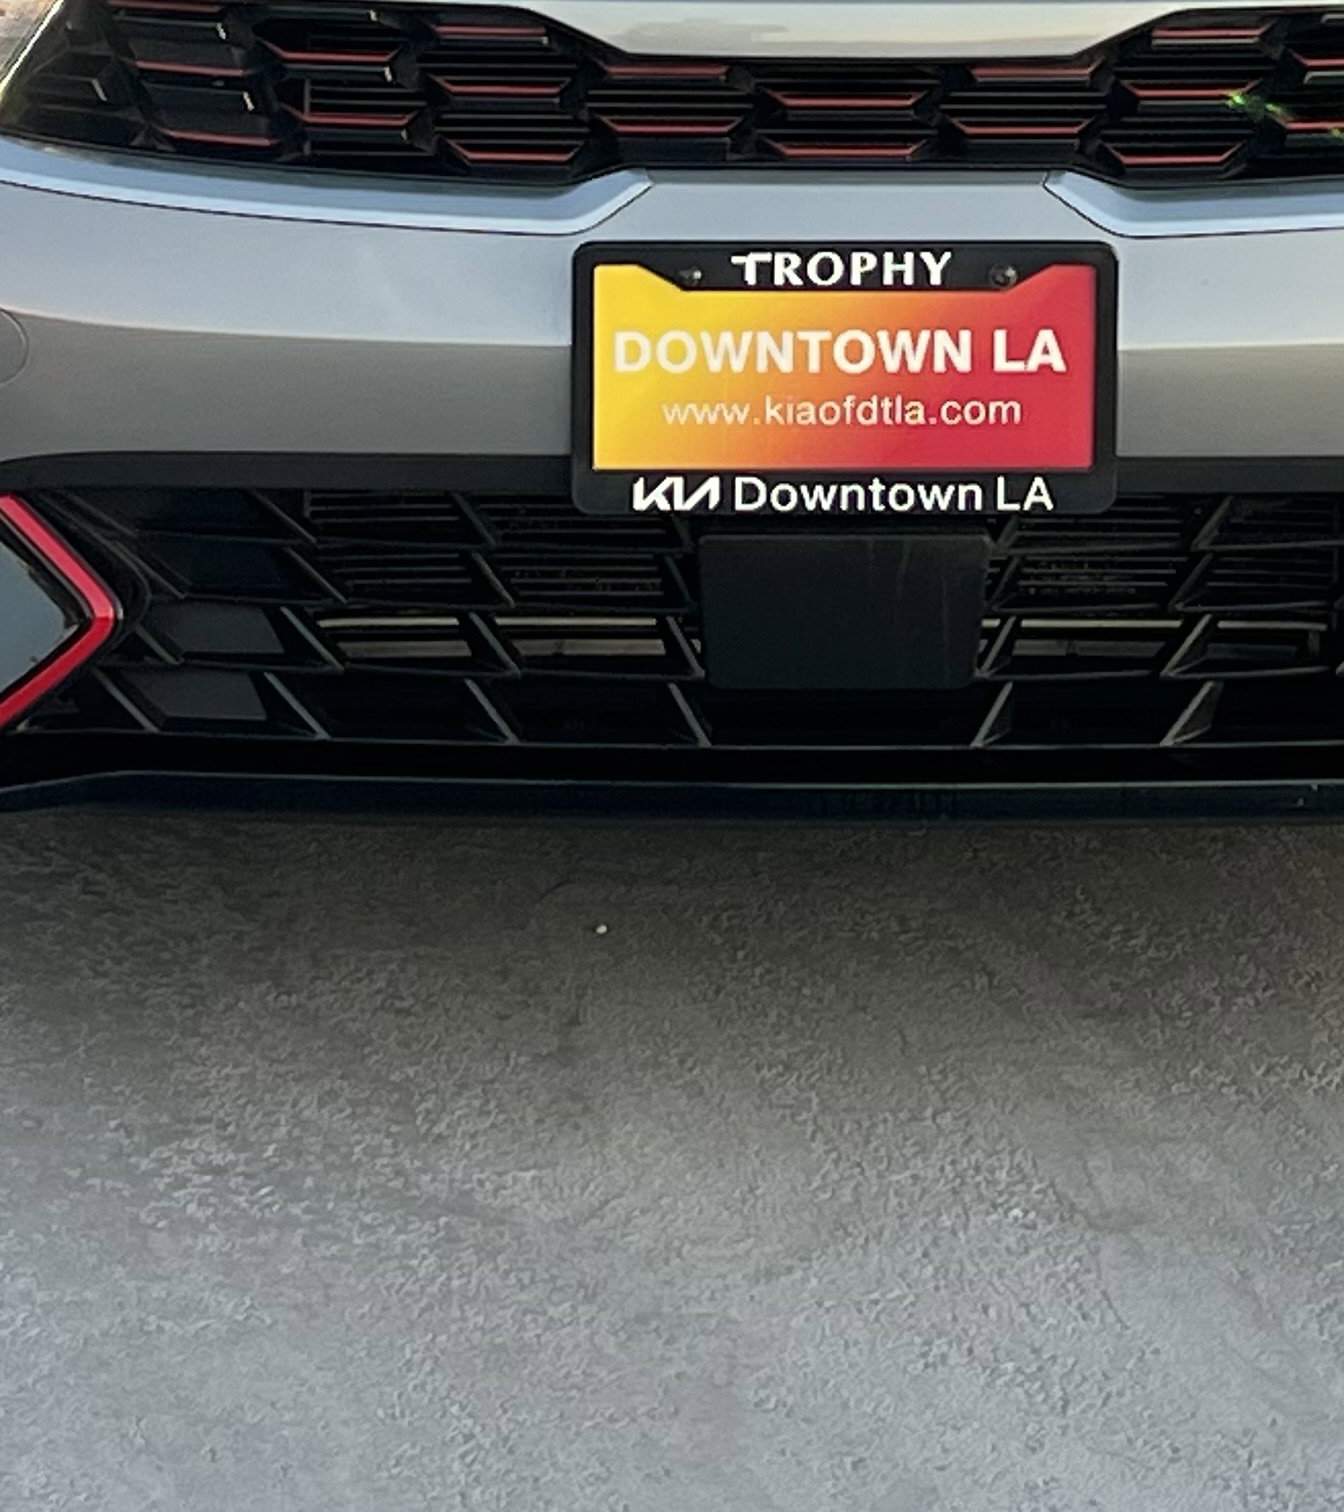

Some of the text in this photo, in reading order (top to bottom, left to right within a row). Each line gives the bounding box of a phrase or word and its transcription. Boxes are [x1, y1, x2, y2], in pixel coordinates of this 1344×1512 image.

[730, 251, 952, 286] TROPHY
[613, 328, 1067, 374] DOWNTOWN LA
[661, 394, 1021, 426] www.kiaofdtla.com
[632, 476, 1054, 512] KIA Downtown LA
